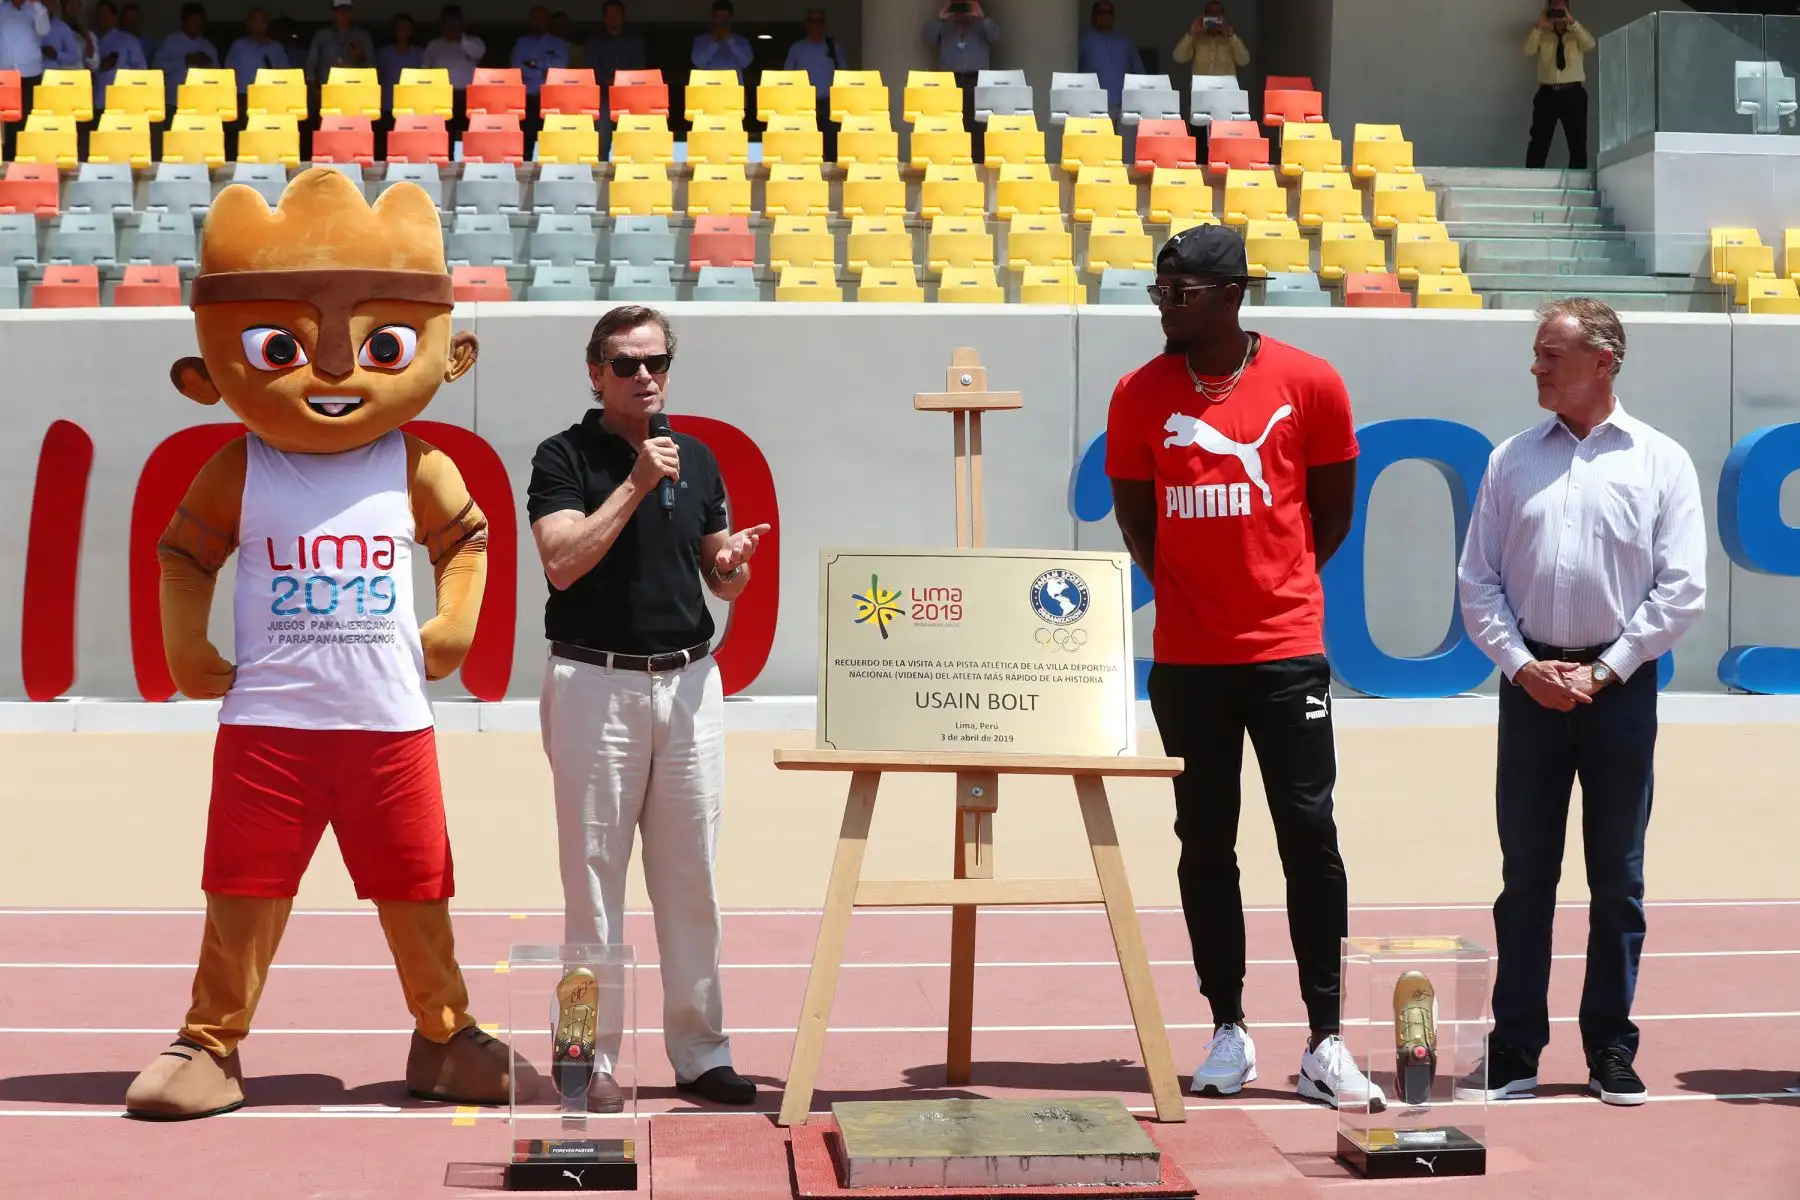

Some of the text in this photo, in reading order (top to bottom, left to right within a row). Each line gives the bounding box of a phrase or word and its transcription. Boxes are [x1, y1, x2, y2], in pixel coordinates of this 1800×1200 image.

[1165, 482, 1251, 519] PUMA
[1034, 571, 1087, 591] PANAM SPORTS
[270, 575, 396, 616] 2019
[911, 603, 963, 621] 2019
[1037, 607, 1084, 624] ORGANIZATION
[267, 620, 396, 631] JUEGOS PANAMERICANOS
[268, 634, 396, 645] Y PARAPANAMERICANOS
[834, 659, 880, 667] RECUERDO
[907, 660, 934, 668] VISITA
[935, 660, 942, 668] A
[944, 660, 955, 668] LA
[981, 660, 1019, 670] ATLÉTICA
[1020, 662, 1032, 670] DE
[1045, 663, 1069, 671] VILLA
[1070, 664, 1118, 672] DEPORTIVA
[848, 671, 1104, 684] NACIONAL (VIDENA) DEL ATLETA MÁS RÁPIDO DE LA HISTORIA
[915, 691, 1040, 711] USAIN BOLT
[955, 722, 999, 731] Lima, Perú
[940, 733, 1014, 743] 3 de abril de 2019
